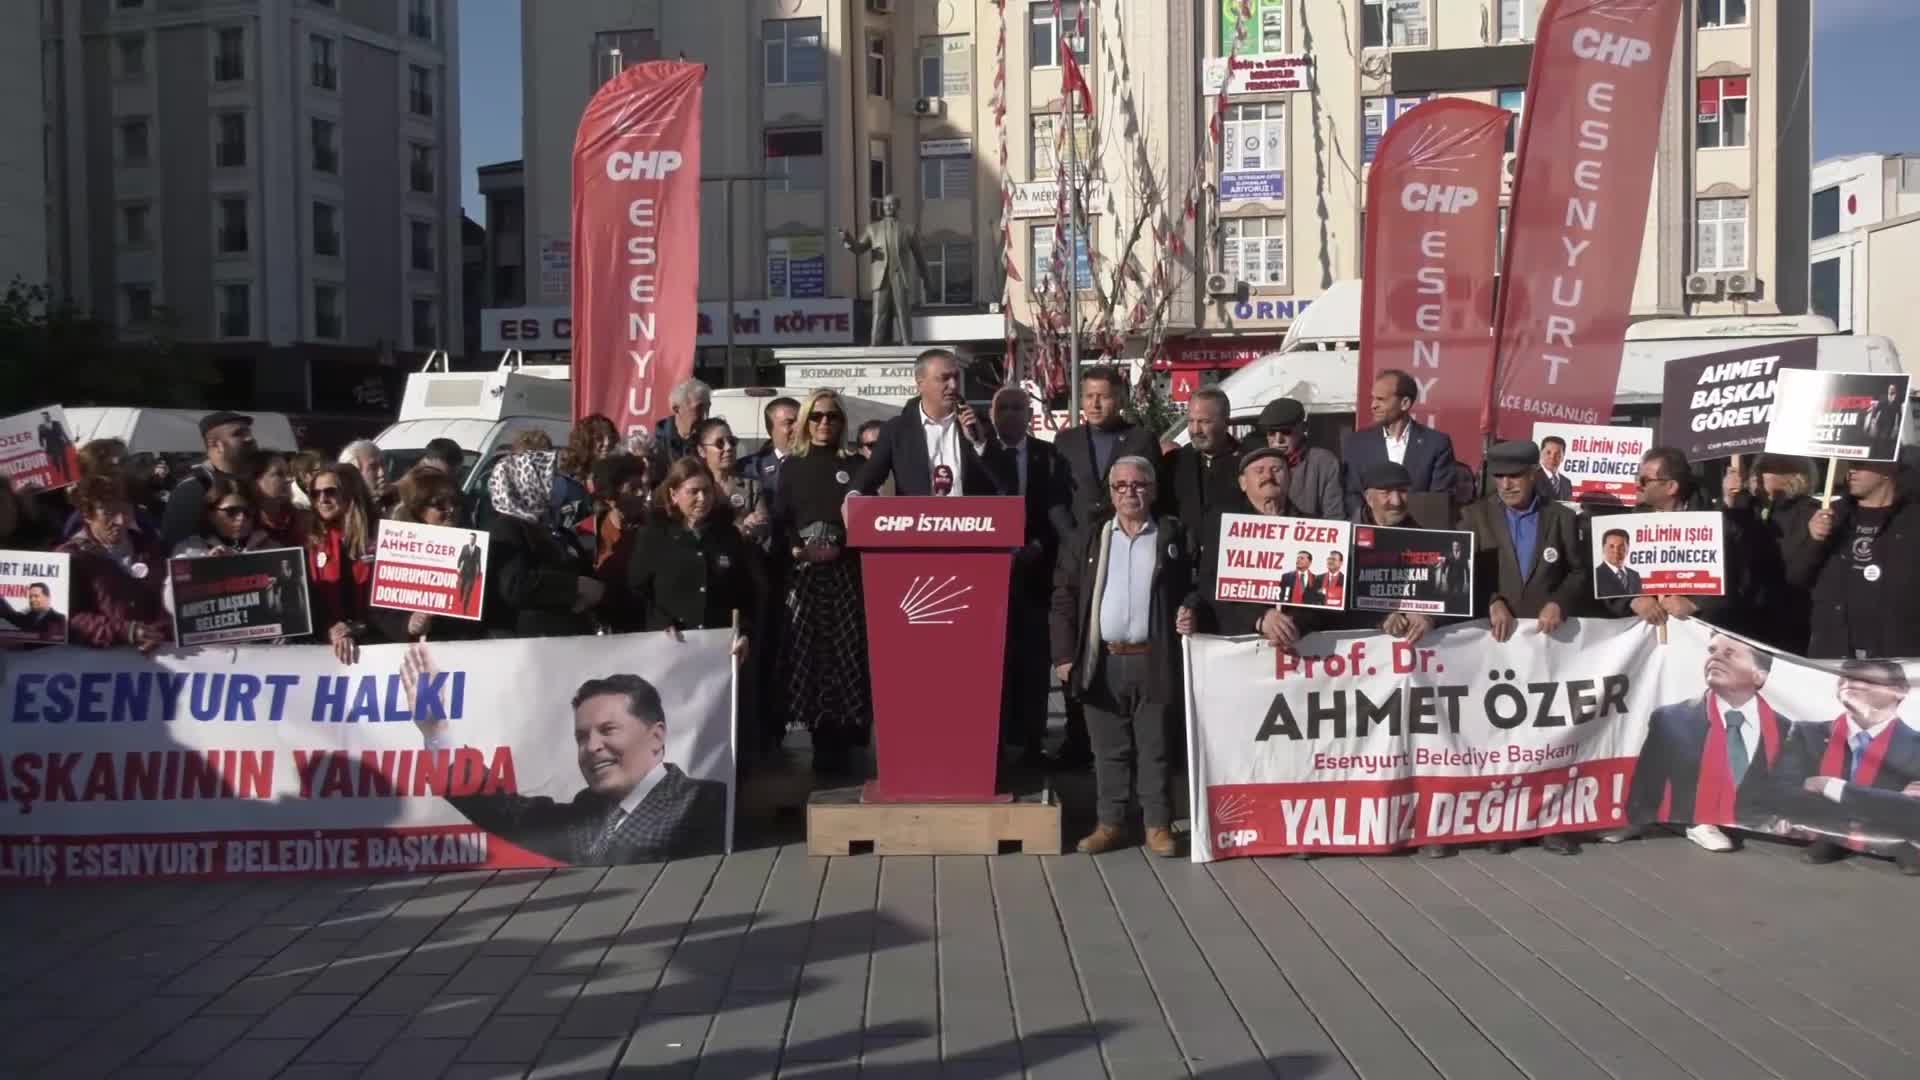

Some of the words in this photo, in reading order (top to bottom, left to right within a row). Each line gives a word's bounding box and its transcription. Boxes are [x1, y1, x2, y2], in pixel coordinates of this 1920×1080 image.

[1572, 27, 1651, 68] CHP
[606, 151, 682, 181] CHP
[1401, 182, 1478, 214] CHP
[1543, 82, 1616, 385] ESENYURT
[500, 319, 540, 340] ES
[774, 310, 849, 333] KÖFTE
[1411, 231, 1447, 420] ESENY
[1697, 355, 1780, 386] AHMET
[1571, 436, 1613, 453] BİLİMİN
[1616, 440, 1642, 456] IŞIĞI
[1564, 457, 1589, 473] GERİ
[875, 516, 914, 532] CHP
[917, 513, 996, 532] İSTANBUL
[1228, 521, 1289, 540] AHMET
[1294, 521, 1339, 543] ÖZER
[1636, 524, 1681, 542] BİLİMİN
[1685, 525, 1713, 544] IŞIĞI
[380, 538, 423, 554] AHMET
[1226, 549, 1285, 570] YALNIZ
[1630, 546, 1657, 564] GERİ
[1660, 546, 1717, 564] DÖNECEK
[22, 562, 60, 578] HALKI
[378, 565, 459, 589] ONURUMUZDUR
[375, 586, 447, 609] DOKUNMAYIN
[448, 595, 454, 609] !
[1220, 580, 1281, 600] DEĞİLDİR
[1284, 586, 1291, 601] !
[1275, 641, 1376, 680] Prof.
[1392, 641, 1444, 675] Dr.
[12, 671, 300, 723] ESENYURT
[311, 671, 466, 723] HALKI
[1255, 684, 1469, 742] AHMET
[1484, 669, 1631, 730] ÖZER
[292, 746, 518, 798] YANINDA
[1314, 749, 1409, 775] Esenyurt
[1415, 747, 1501, 770] Belediye
[1508, 742, 1580, 765] Başkanı
[1280, 792, 1418, 847] YALNIZ
[1427, 765, 1600, 838] DEĞİLDİR
[1611, 773, 1625, 819] !
[1217, 828, 1260, 849] CHP
[65, 839, 217, 877] ESENYURT
[224, 831, 361, 873] BELEDİYE
[367, 834, 488, 871] BAŞKANI
